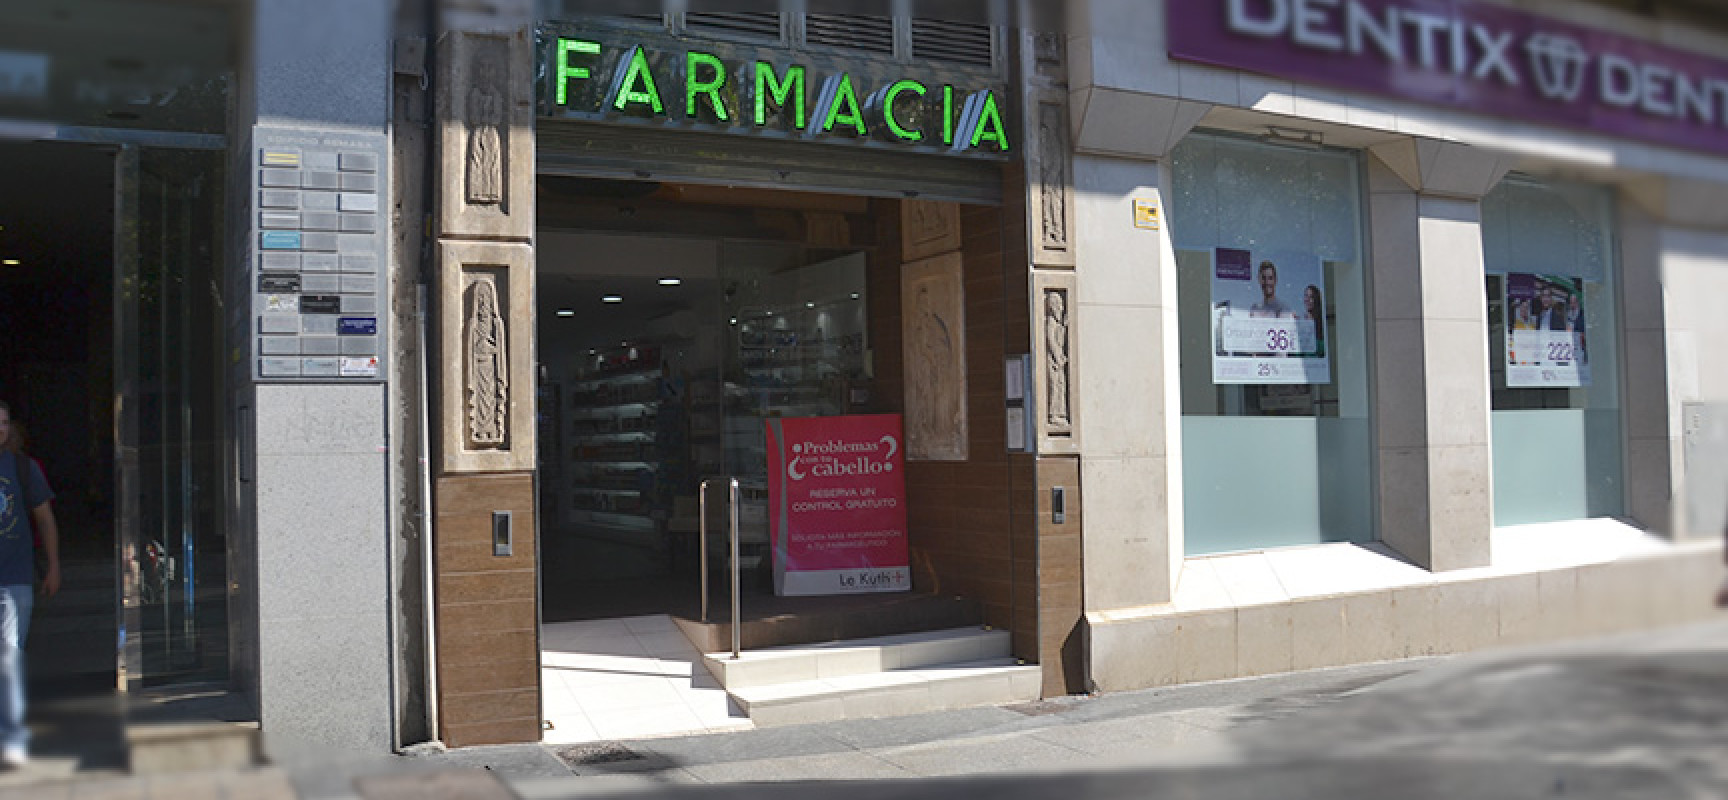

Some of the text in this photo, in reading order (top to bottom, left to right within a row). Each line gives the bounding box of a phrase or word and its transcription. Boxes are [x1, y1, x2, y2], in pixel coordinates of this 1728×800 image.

[1228, 0, 1519, 85] DENTIX
[555, 36, 1009, 152] FARMACIA
[792, 498, 897, 512] CONTROL GRATUITO
[809, 488, 877, 498] RESERVA UN
